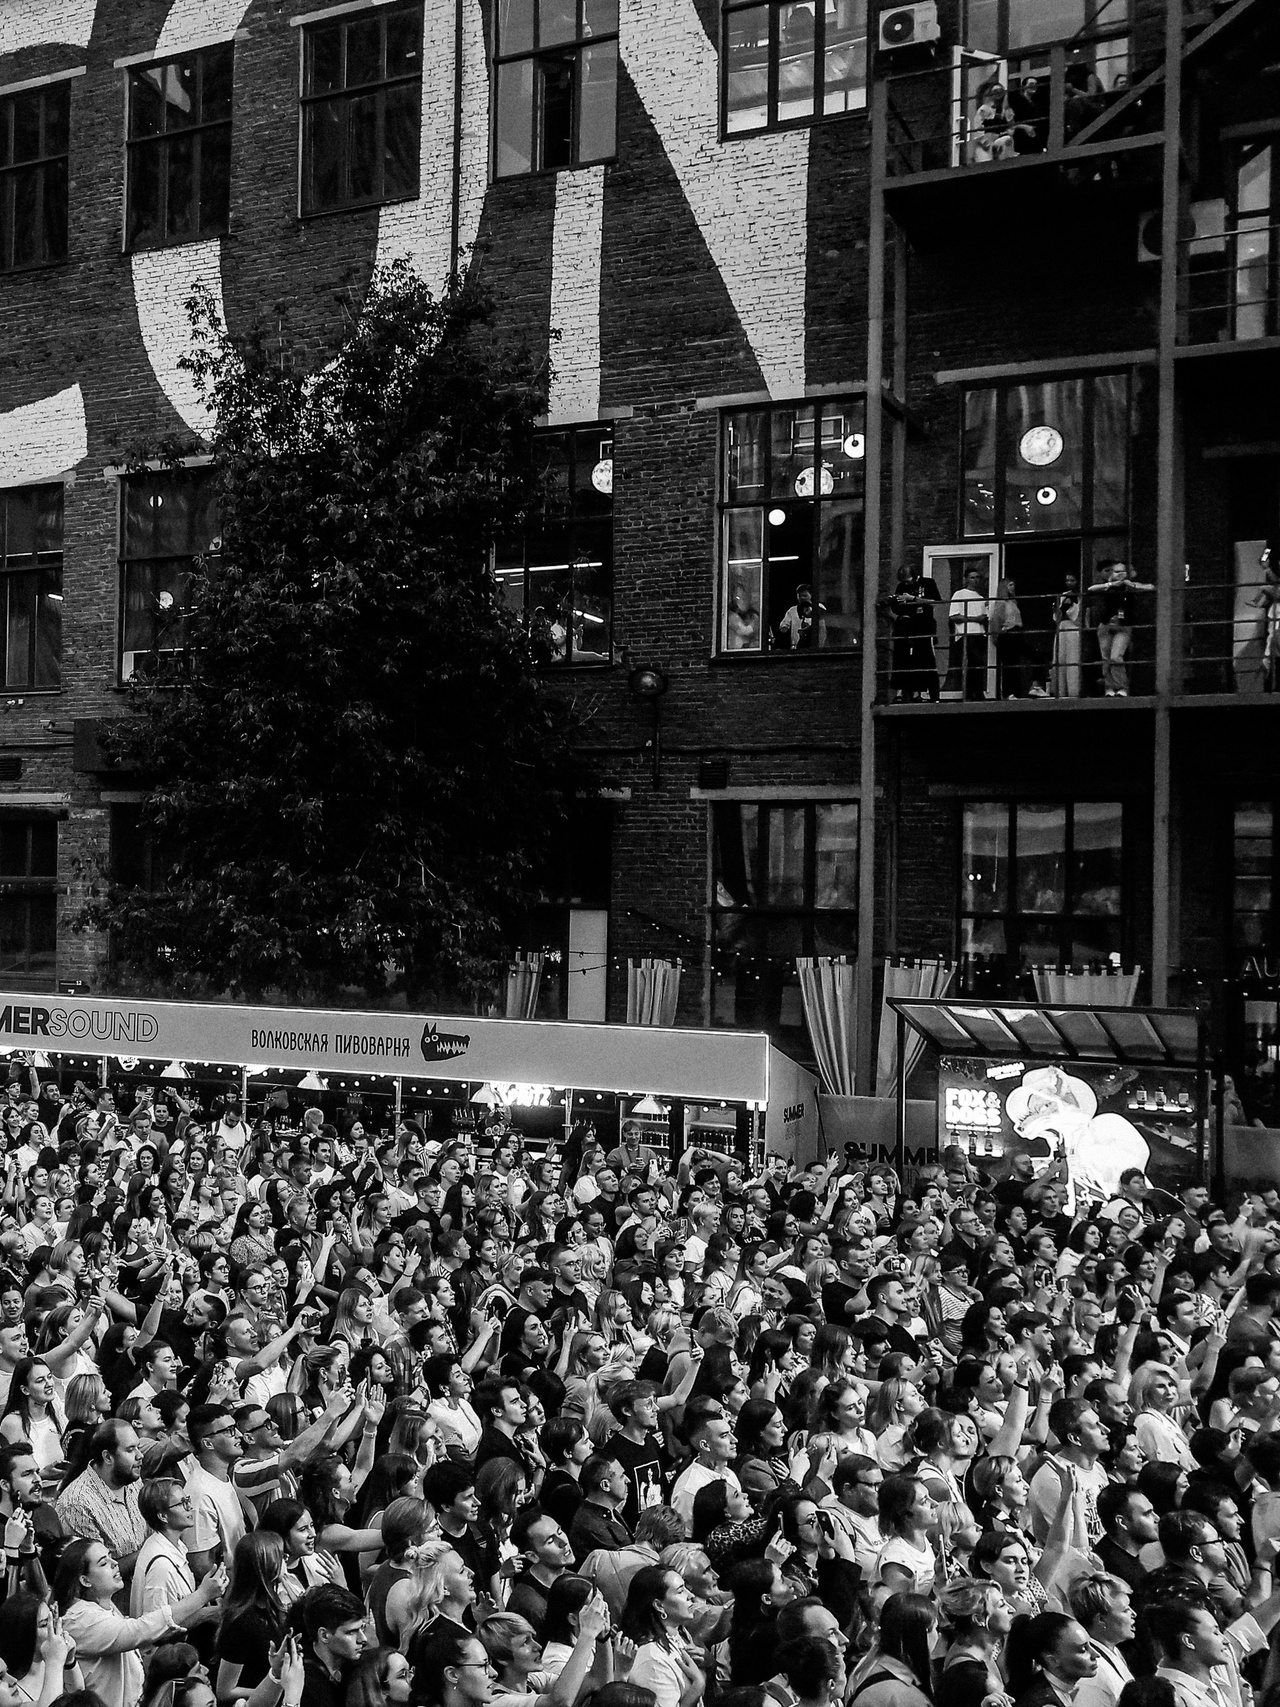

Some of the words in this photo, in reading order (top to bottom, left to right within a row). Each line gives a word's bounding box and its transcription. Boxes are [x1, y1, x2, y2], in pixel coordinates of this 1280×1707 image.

[251, 1029, 328, 1052] ВОЛКОВСКАЯ
[335, 1034, 410, 1057] ПИВОВАРНЯ
[783, 1102, 805, 1123] SUMMER
[945, 1105, 1001, 1126] DOGS
